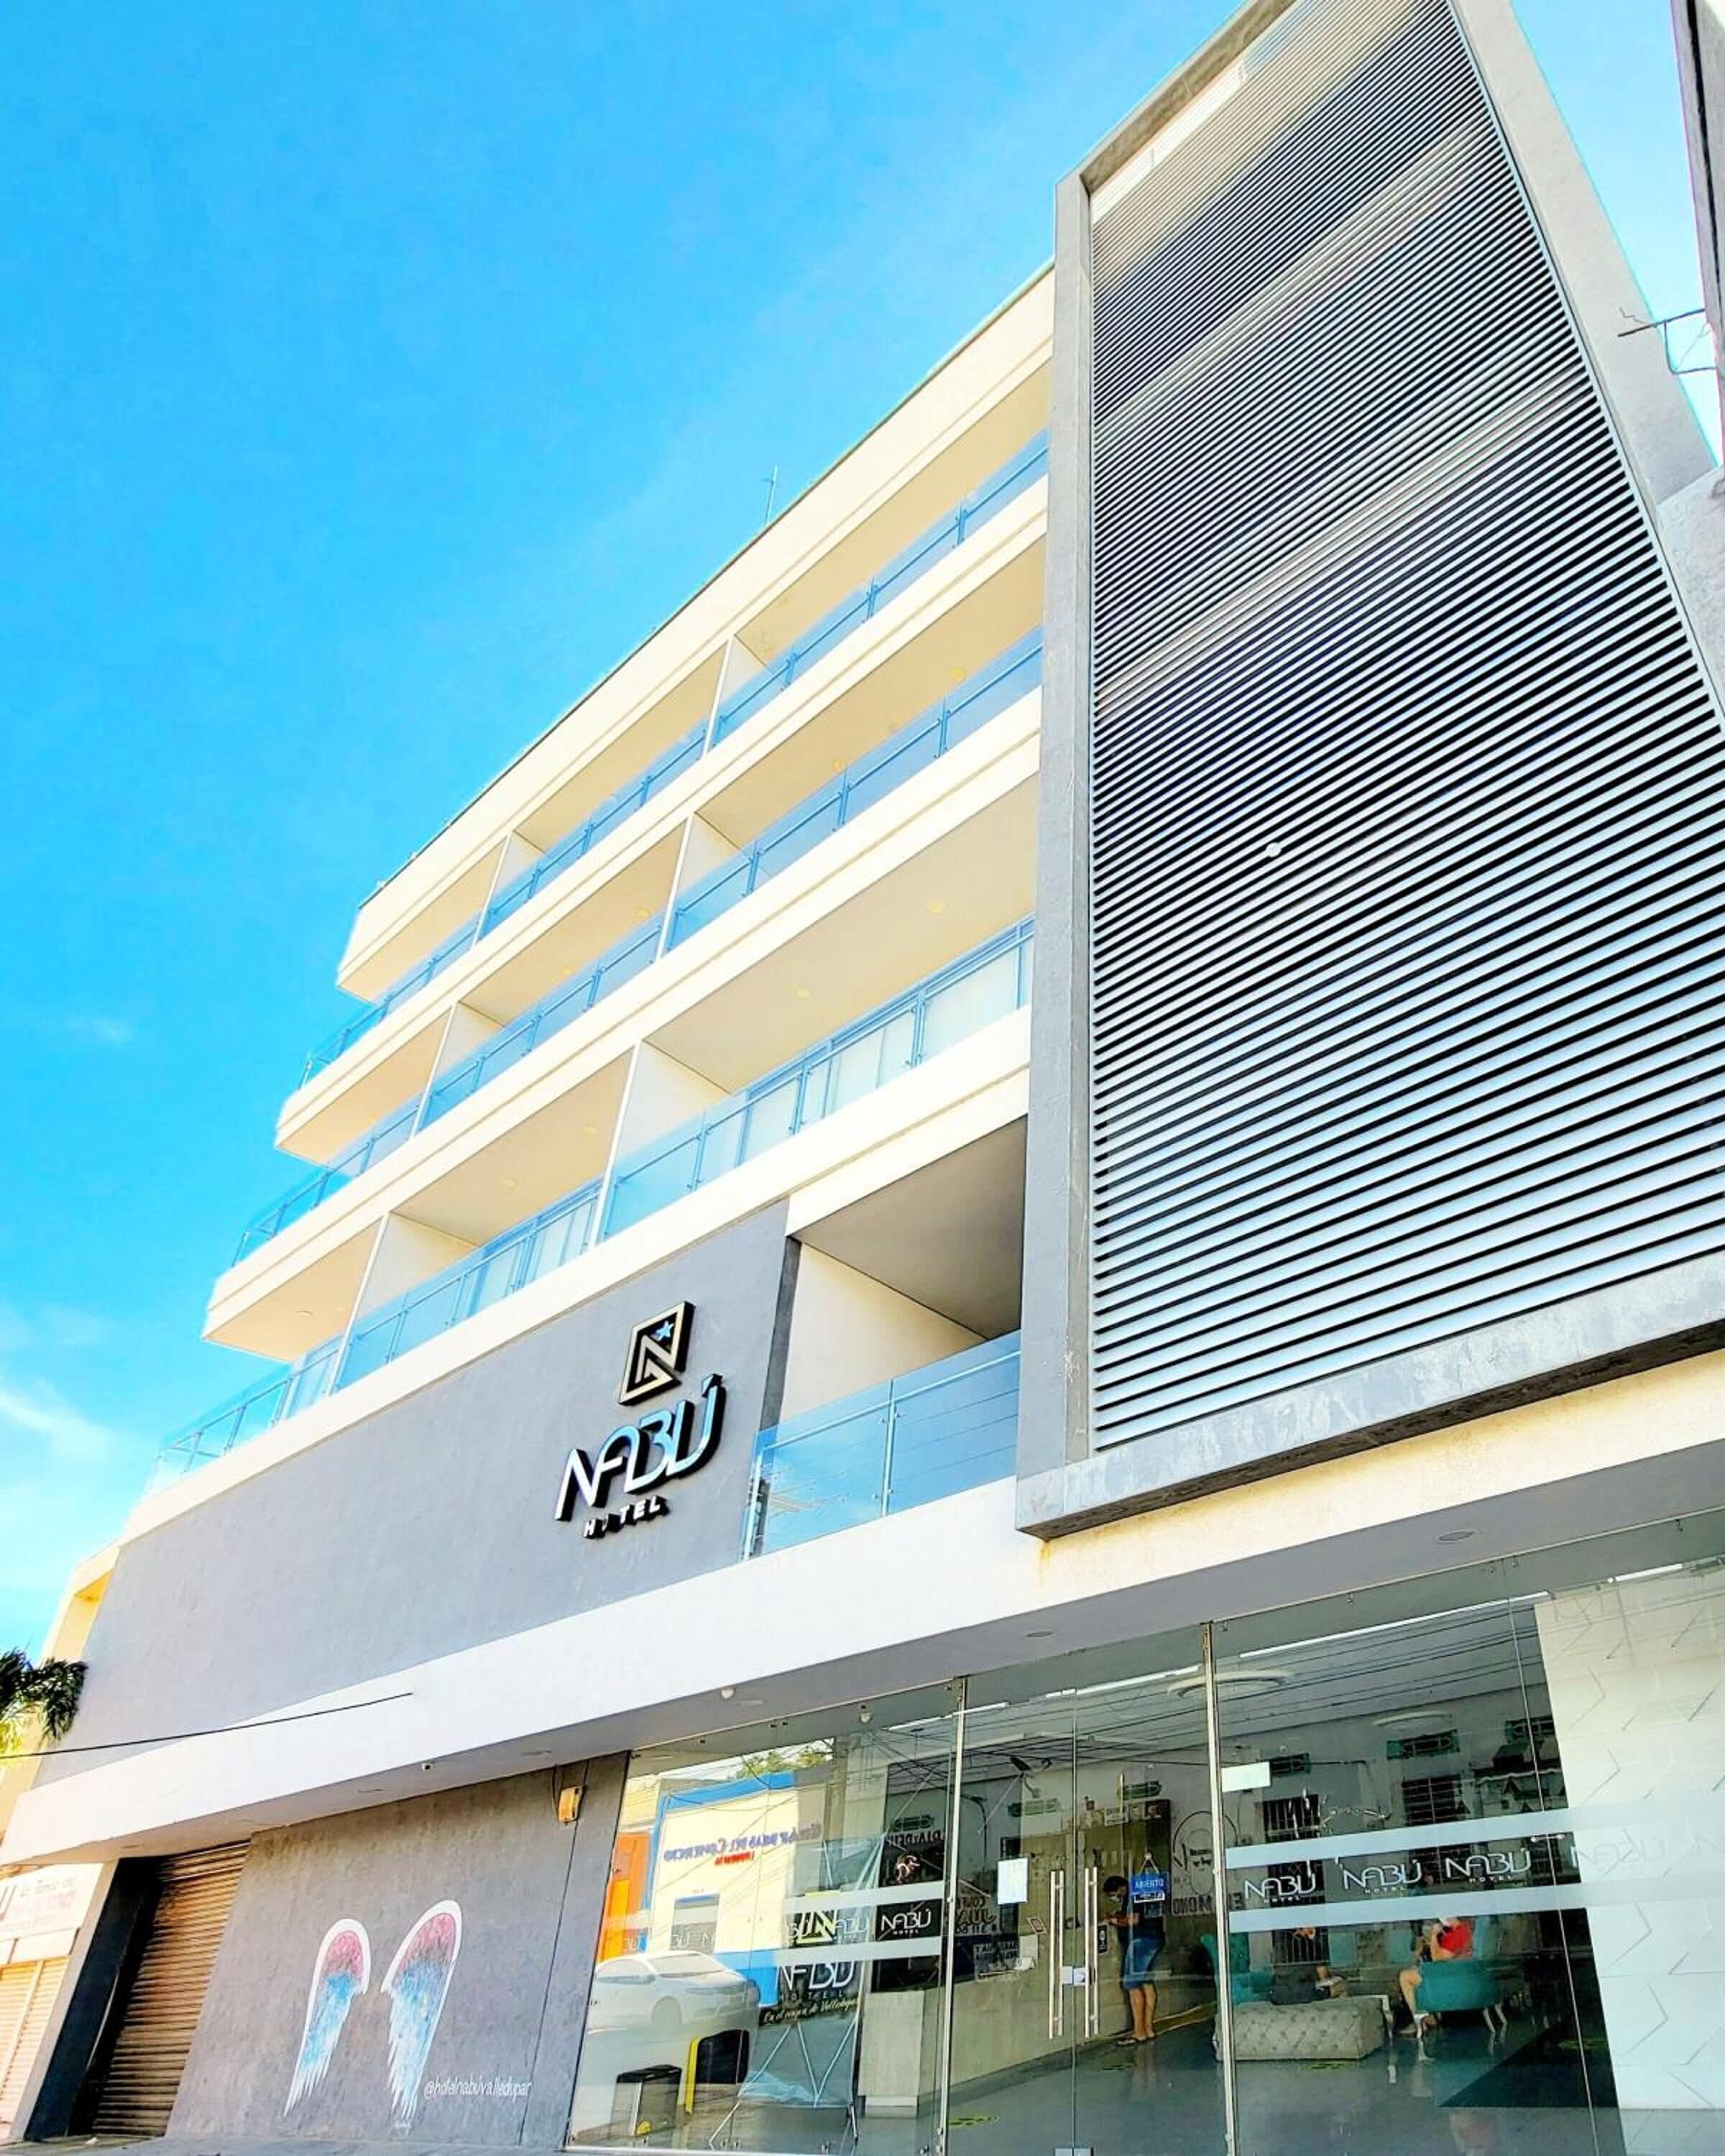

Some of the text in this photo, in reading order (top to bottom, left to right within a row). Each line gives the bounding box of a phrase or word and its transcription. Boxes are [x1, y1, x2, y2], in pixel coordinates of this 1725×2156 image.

[583, 1495, 671, 1540] HOTEL
[1365, 1886, 1405, 1894] HOTEL
[1264, 1895, 1302, 1904] HOTEL
